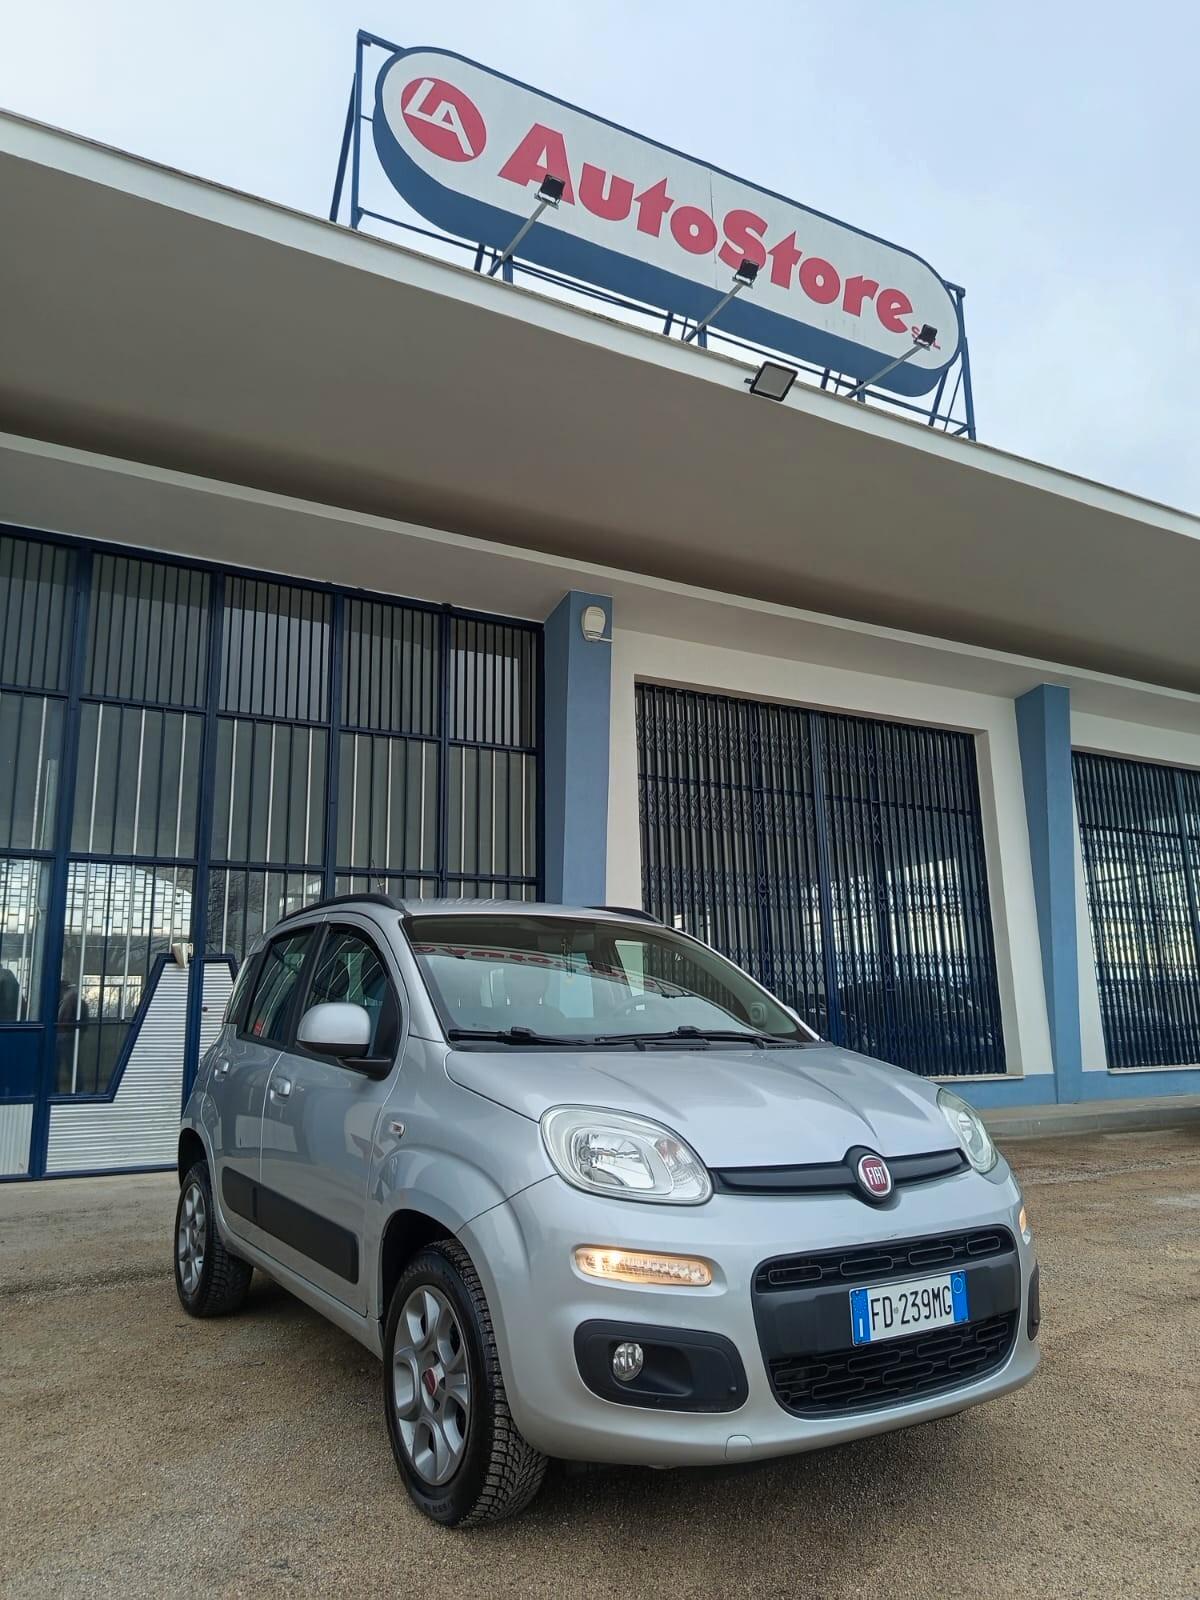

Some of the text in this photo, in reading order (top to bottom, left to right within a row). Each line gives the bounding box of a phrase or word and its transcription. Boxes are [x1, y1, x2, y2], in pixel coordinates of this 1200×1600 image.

[403, 79, 476, 158] LA
[499, 123, 913, 334] AutoStore
[865, 1166, 886, 1186] FIAT
